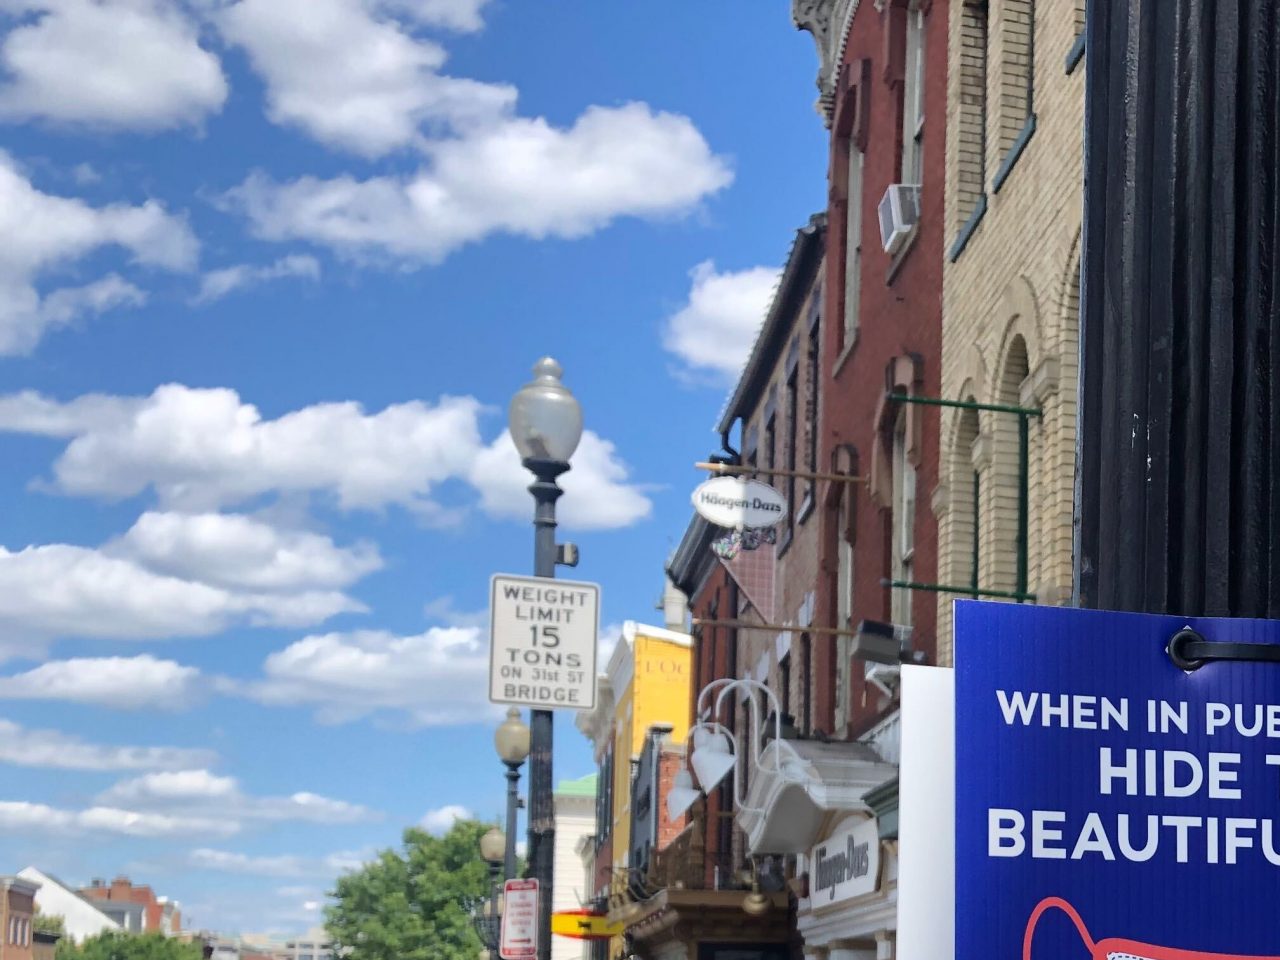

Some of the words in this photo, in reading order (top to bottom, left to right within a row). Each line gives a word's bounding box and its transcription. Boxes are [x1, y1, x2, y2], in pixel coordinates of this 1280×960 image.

[503, 585, 588, 607] WEIGHT
[516, 605, 574, 624] LIMIT
[530, 625, 560, 649] 15
[505, 648, 582, 668] TONS
[500, 665, 522, 679] ON
[567, 670, 584, 684] ST
[504, 683, 580, 703] BRIDGE
[996, 690, 1128, 730] WHEN
[1148, 700, 1187, 733] IN
[1100, 748, 1241, 799] HIDE
